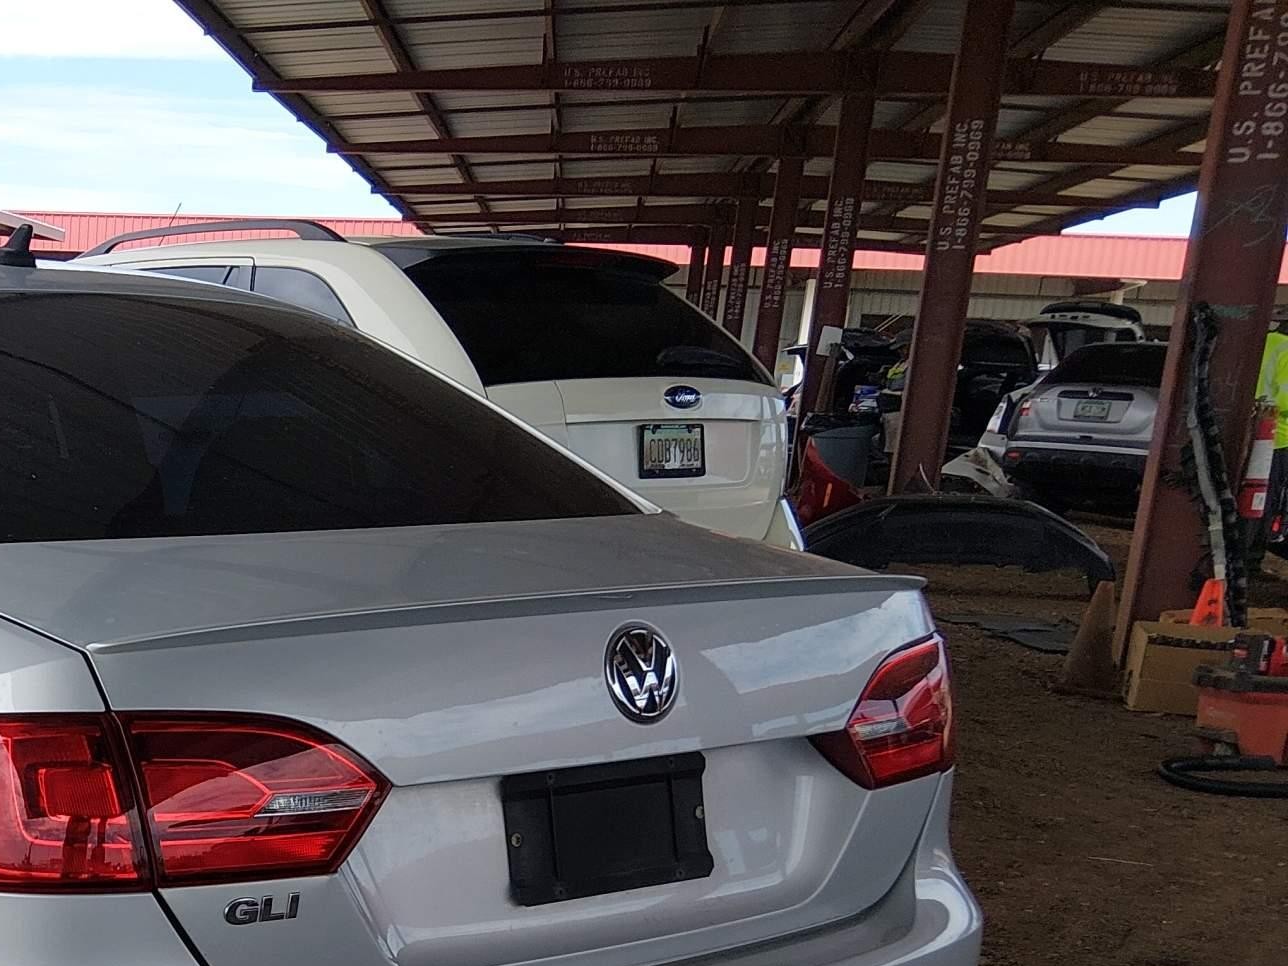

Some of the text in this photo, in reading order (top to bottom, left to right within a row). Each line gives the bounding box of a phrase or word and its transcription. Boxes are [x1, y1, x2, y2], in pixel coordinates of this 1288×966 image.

[1226, 0, 1276, 164] U.S. PREFA
[941, 155, 965, 214] PREFAB
[826, 222, 842, 264] PREFAB
[936, 223, 954, 251] U.S.
[223, 892, 301, 926] GLI
